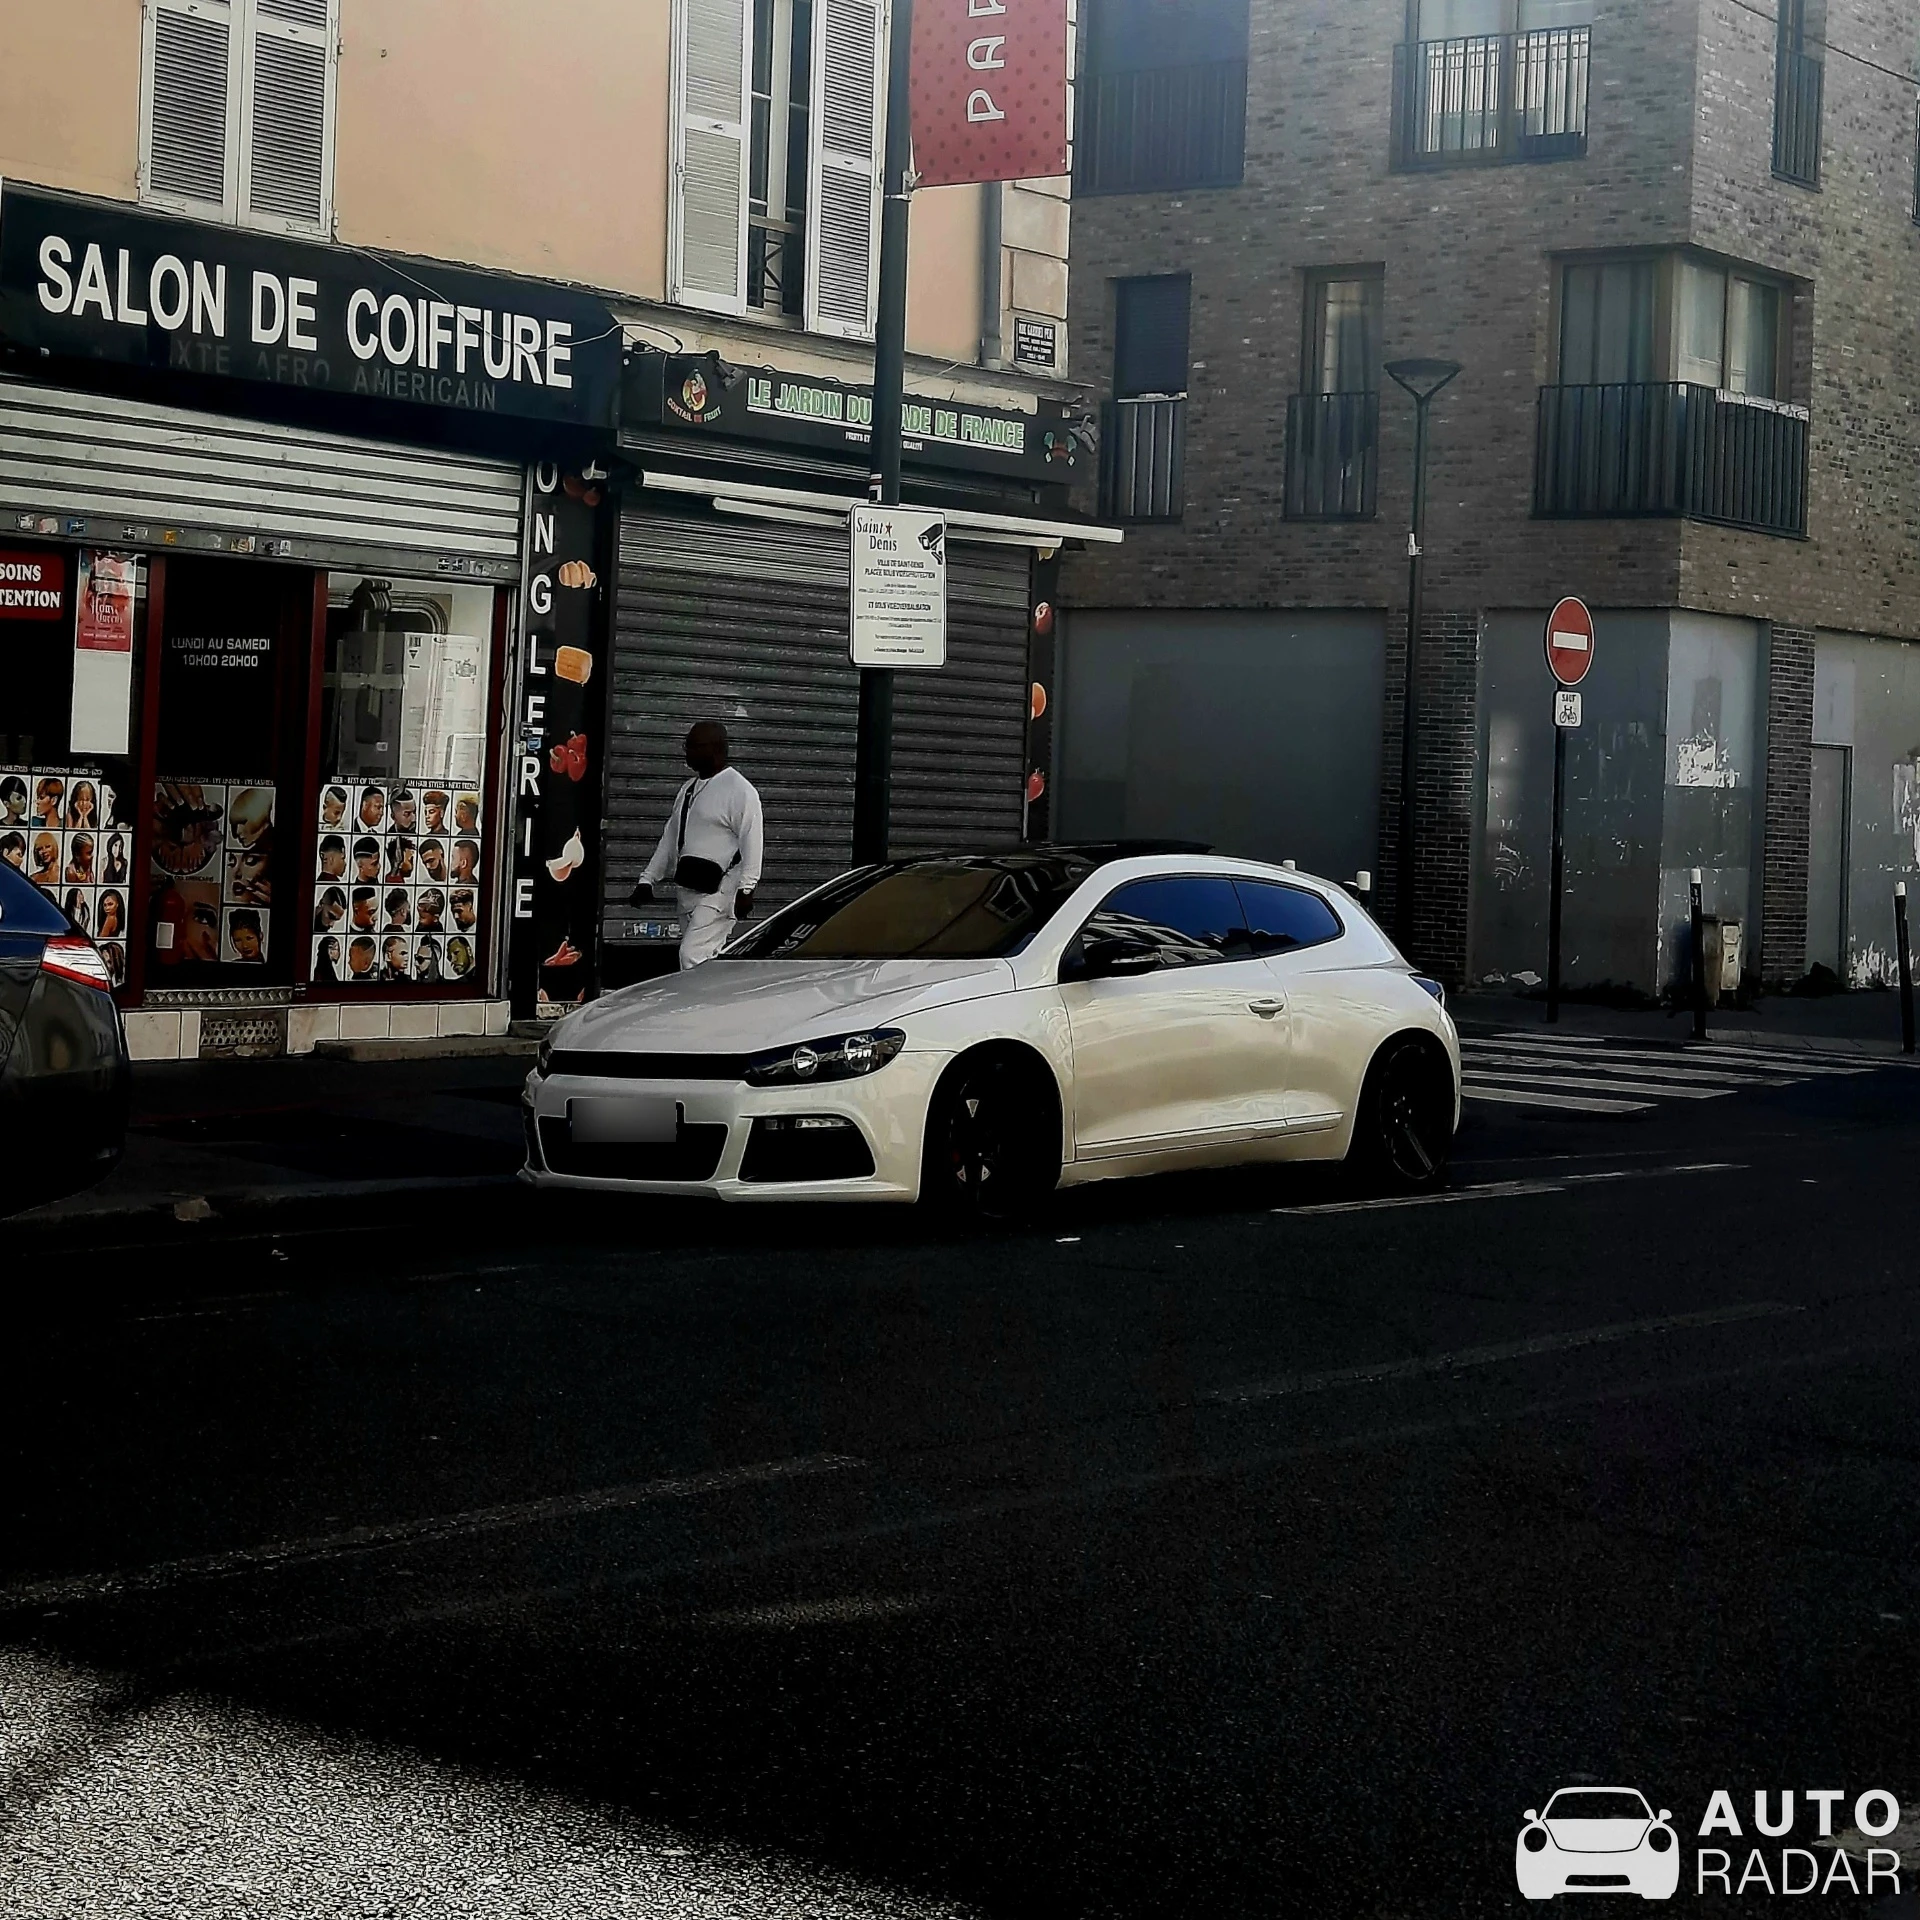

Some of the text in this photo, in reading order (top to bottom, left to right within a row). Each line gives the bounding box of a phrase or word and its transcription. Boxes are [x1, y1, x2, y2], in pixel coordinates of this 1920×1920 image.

[37, 234, 573, 390] SALON DE COIFFURE
[353, 366, 496, 411] AMERICAIN
[747, 377, 1025, 449] LE JARDIN DU ADE DE FRANCE
[856, 516, 884, 534] Saint
[869, 535, 898, 552] Denis
[0, 562, 42, 582] SOINS
[171, 637, 270, 651] LUNDI AU SAMEDI
[183, 654, 259, 668] 10H00 20H00
[514, 459, 559, 918] ONGLERIE
